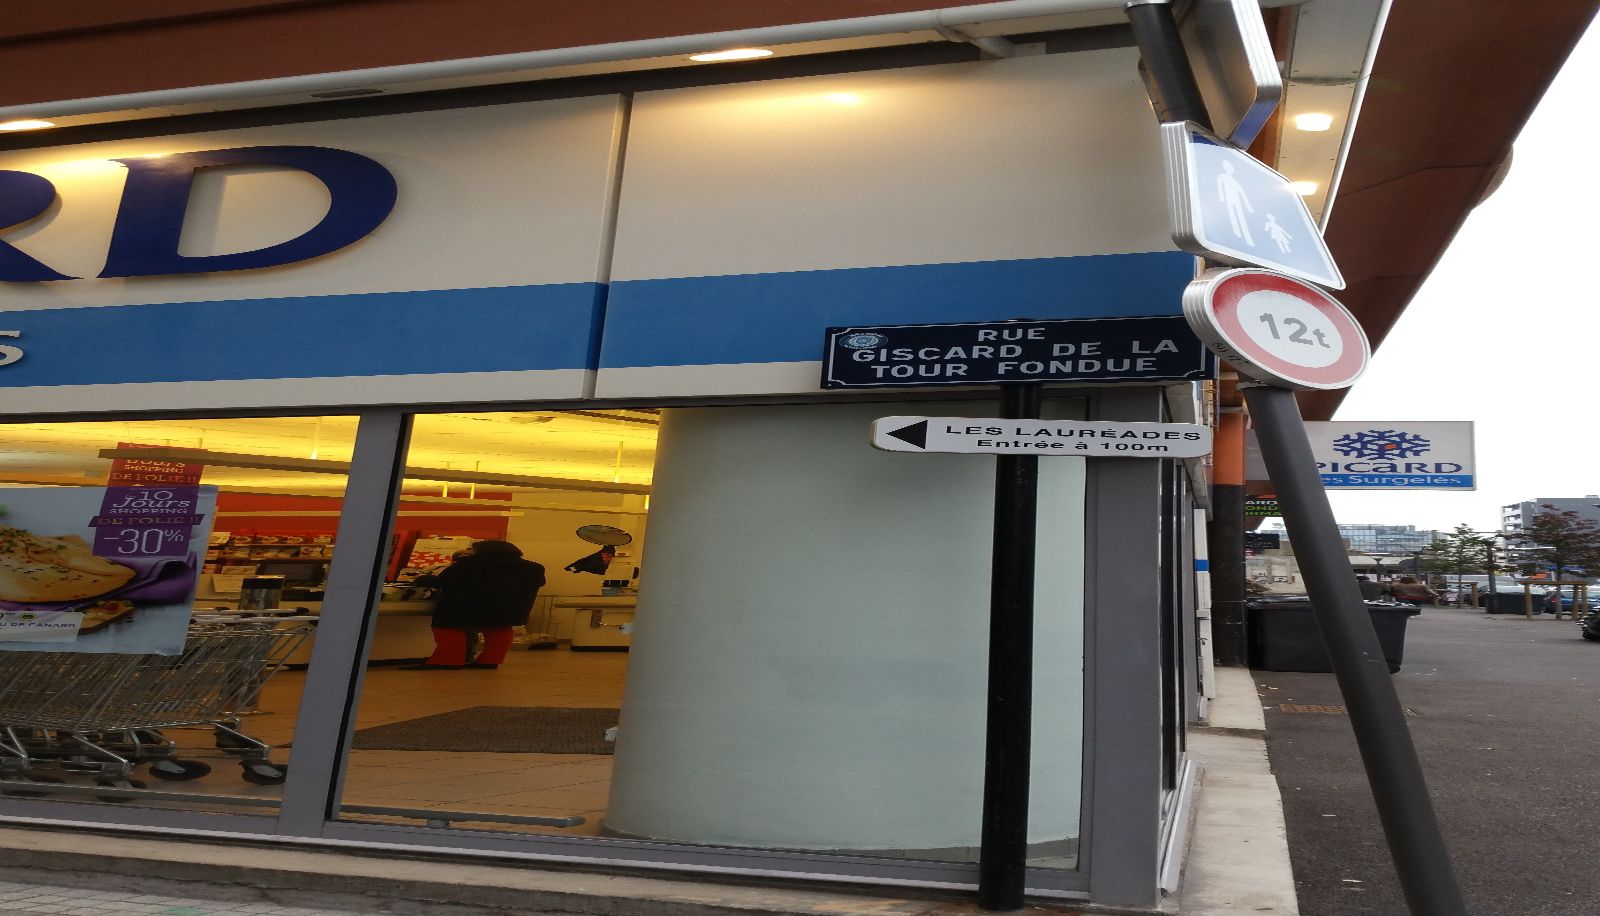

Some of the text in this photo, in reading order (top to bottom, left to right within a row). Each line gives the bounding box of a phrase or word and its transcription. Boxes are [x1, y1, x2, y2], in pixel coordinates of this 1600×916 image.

[977, 327, 1046, 342] RUE
[1258, 312, 1332, 349] 12t
[852, 339, 1180, 362] GISCARD DE LA
[871, 357, 1158, 378] TOUR FONDUE
[946, 425, 1201, 441] LES LAURÉADES
[977, 439, 1169, 452] Entrée à 100m
[1350, 475, 1462, 486] Surgelés
[112, 497, 191, 508] Jours
[139, 490, 174, 501] 10
